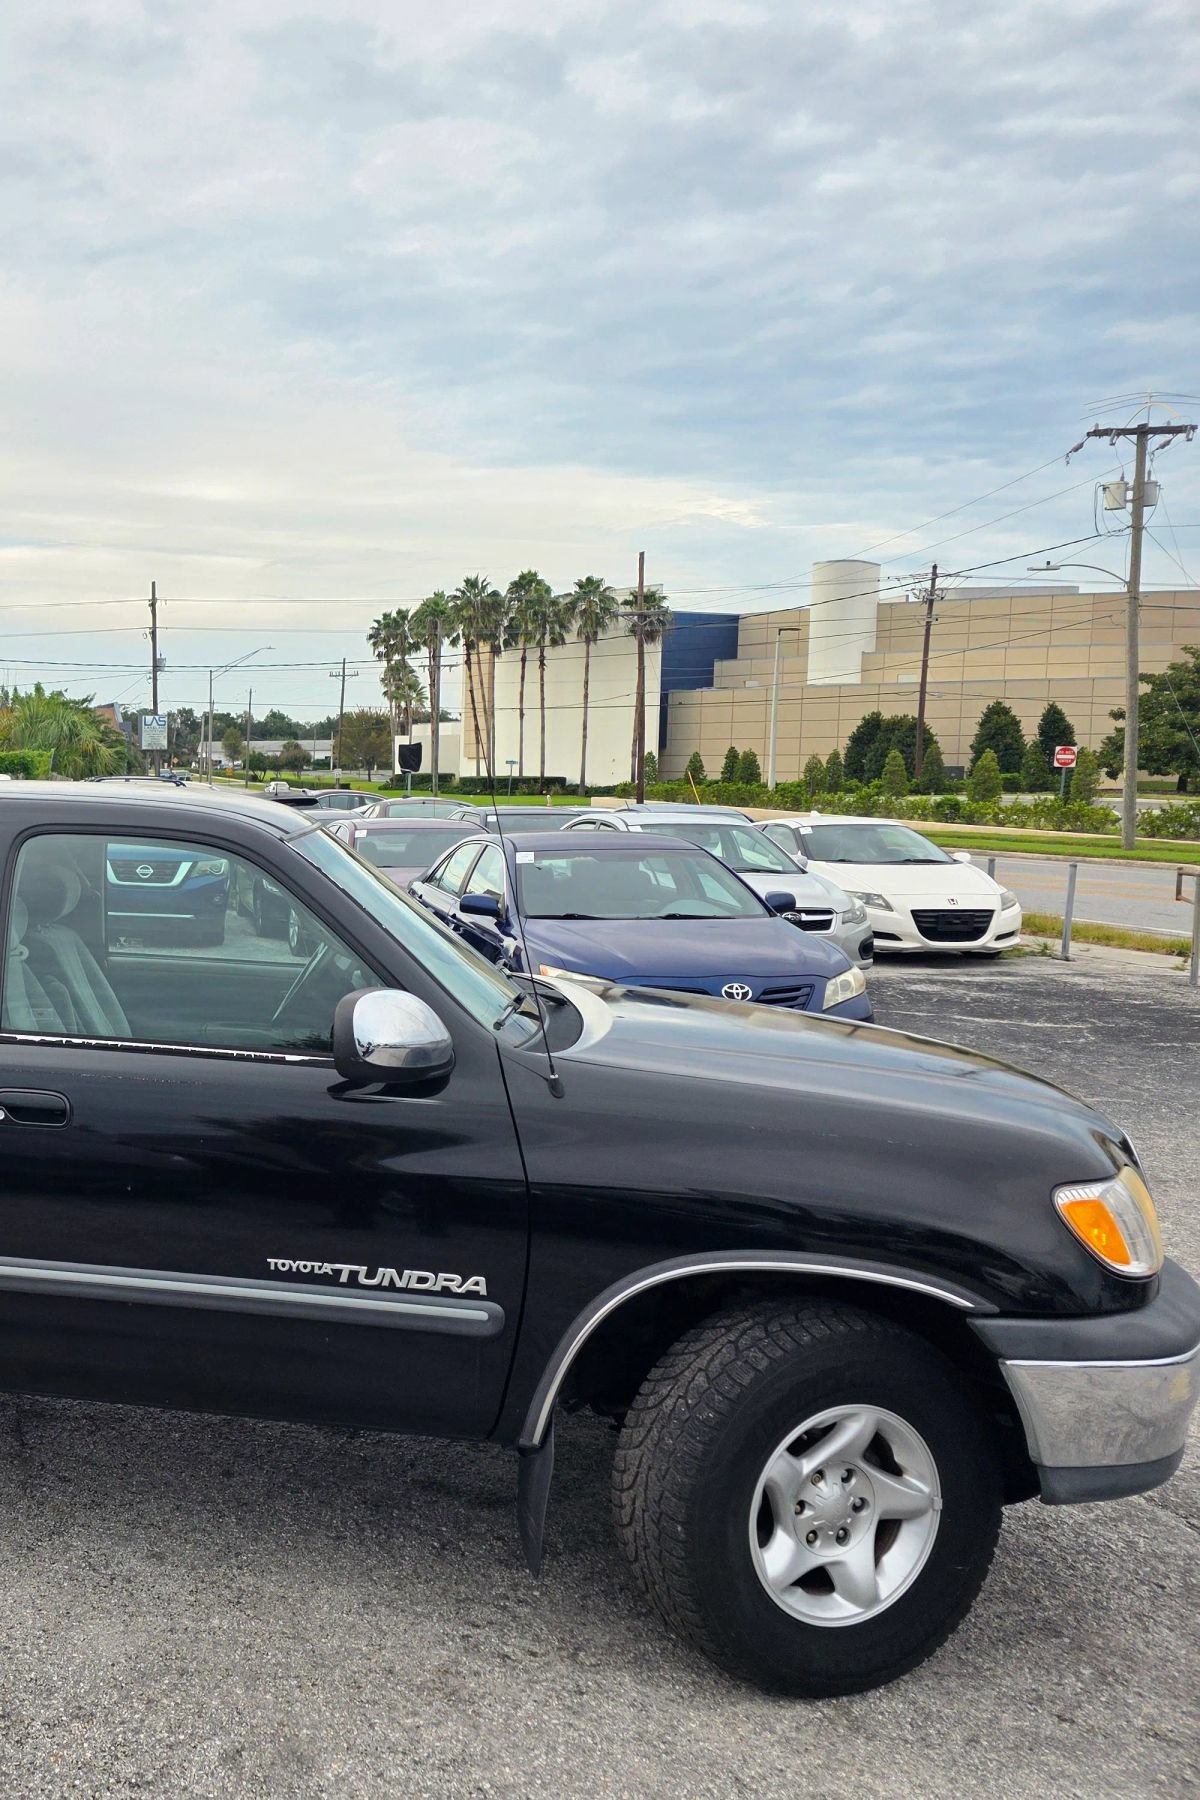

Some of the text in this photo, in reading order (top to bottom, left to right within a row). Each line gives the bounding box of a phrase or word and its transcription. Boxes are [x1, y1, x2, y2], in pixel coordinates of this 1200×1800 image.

[144, 716, 166, 726] LAS
[266, 1258, 488, 1296] TOYOTA TUNDRA
